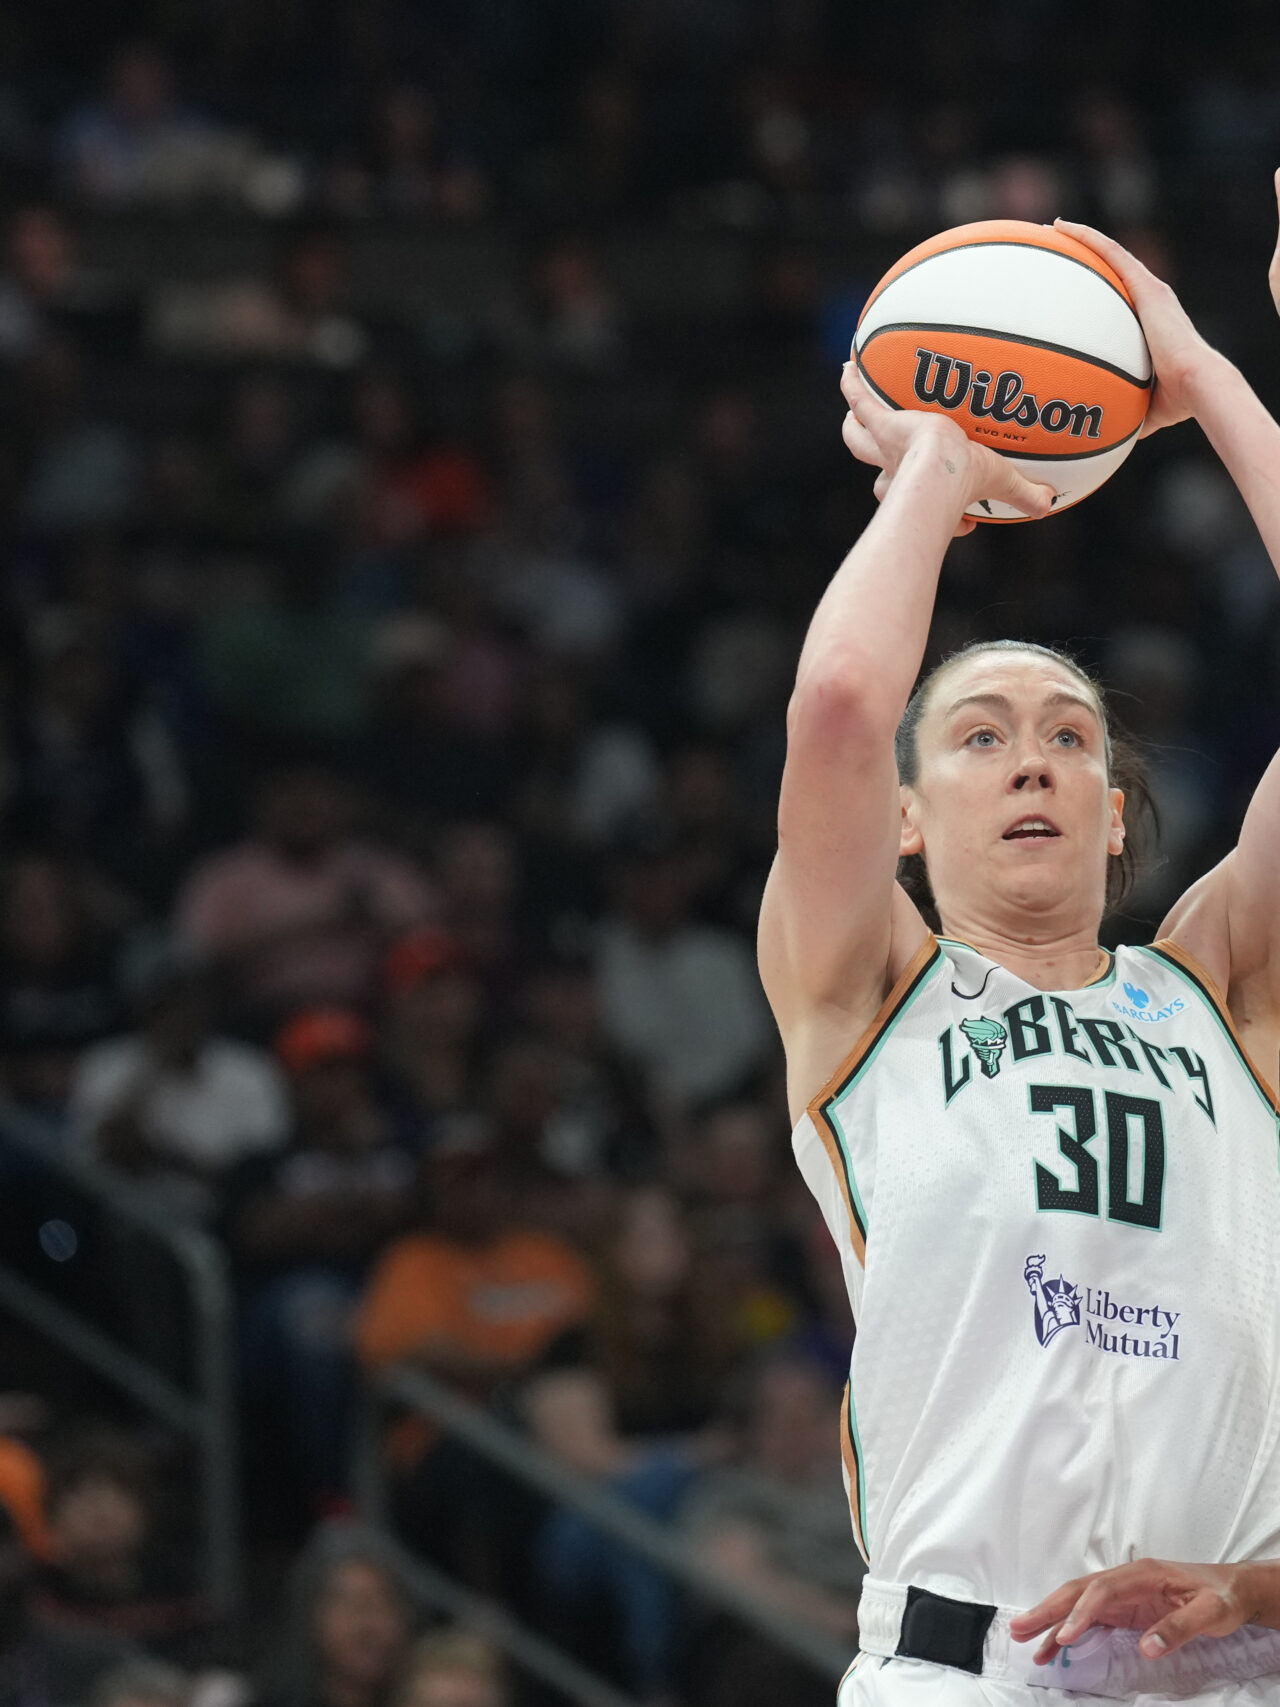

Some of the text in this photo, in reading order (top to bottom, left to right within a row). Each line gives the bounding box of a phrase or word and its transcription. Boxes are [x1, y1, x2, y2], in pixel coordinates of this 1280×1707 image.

[913, 347, 1103, 439] Wilson
[975, 426, 1027, 442] EVO NXT
[1112, 998, 1185, 1022] BARCLAYS
[1027, 1083, 1167, 1232] 30
[1086, 1287, 1181, 1339] Liberty
[1086, 1319, 1180, 1361] Mutual
